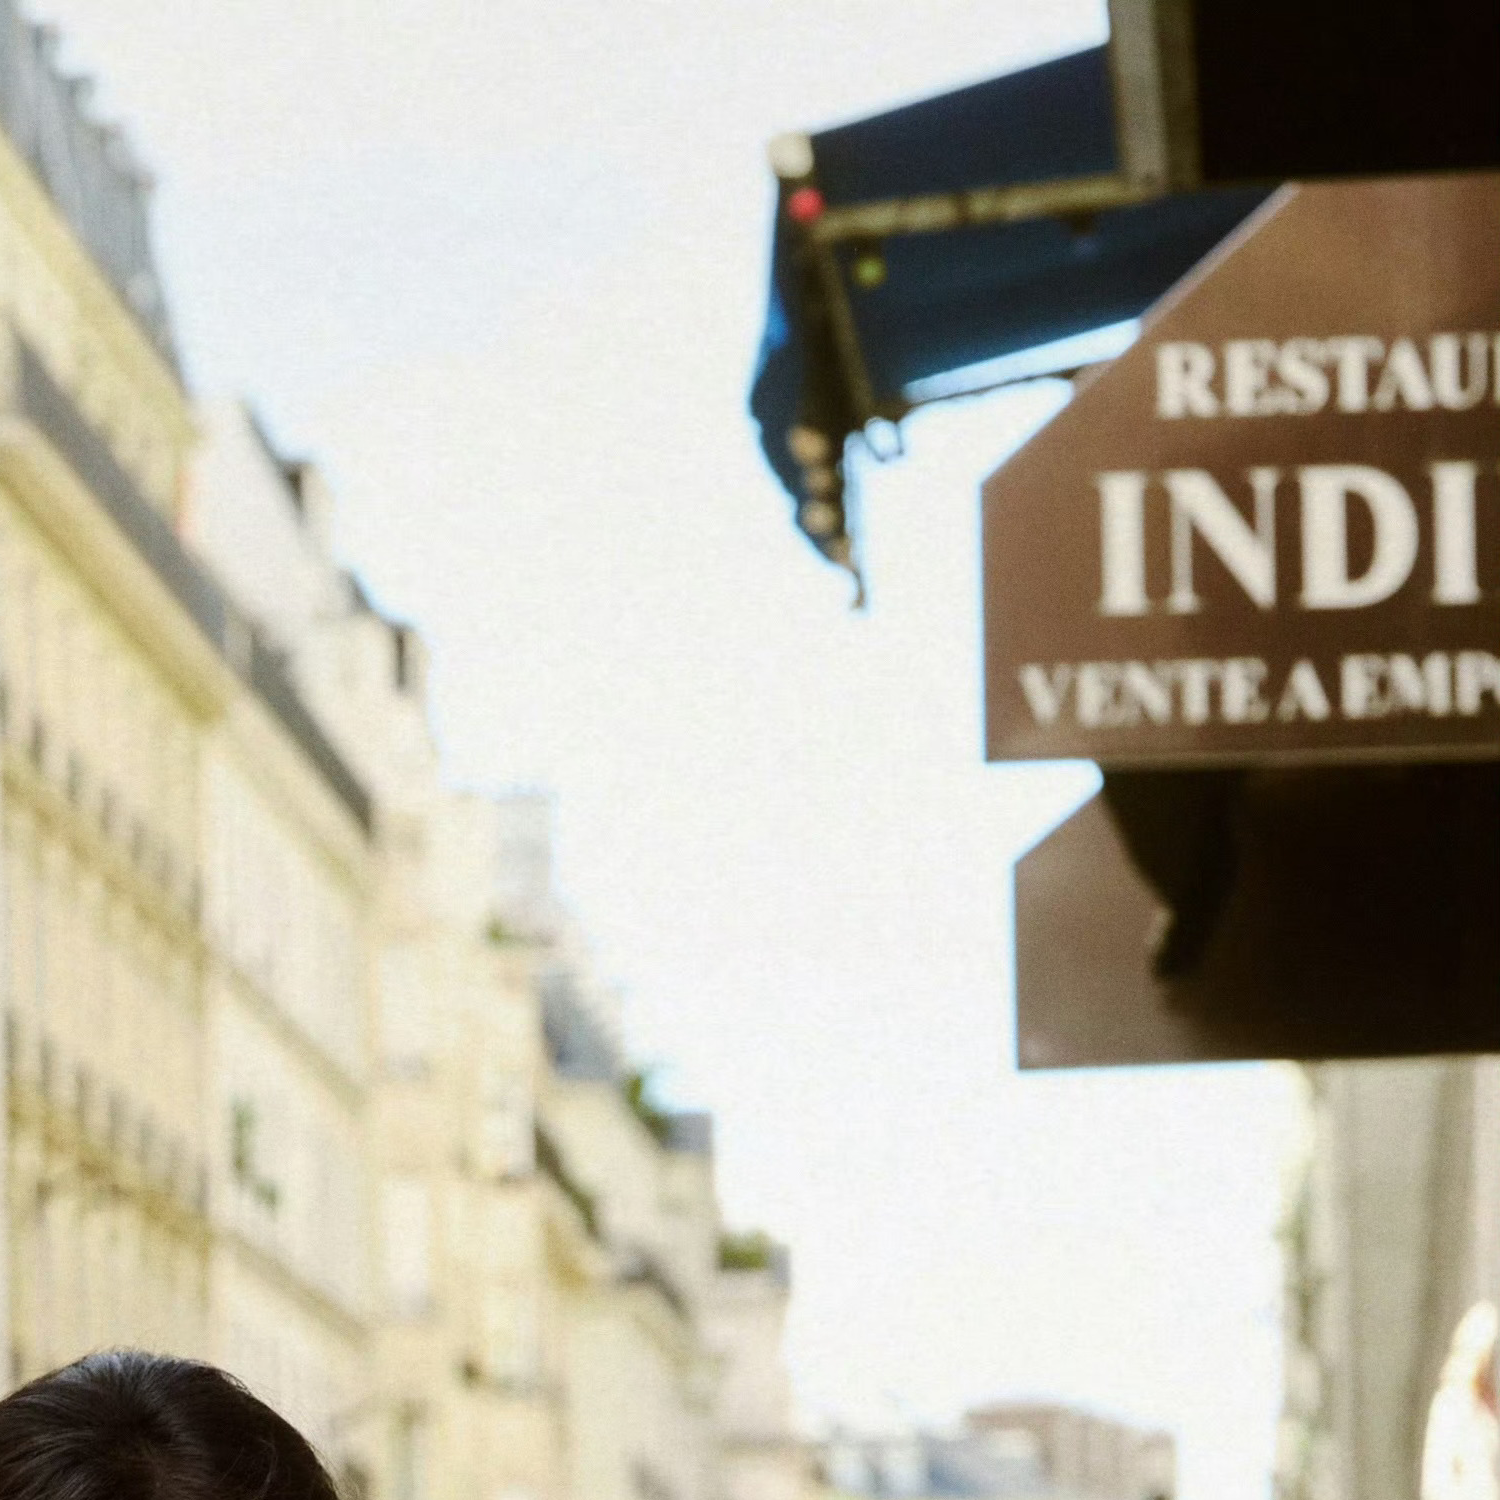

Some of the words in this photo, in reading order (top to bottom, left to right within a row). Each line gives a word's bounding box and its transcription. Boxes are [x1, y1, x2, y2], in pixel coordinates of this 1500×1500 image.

[1155, 331, 1500, 420] RESTAU
[1018, 655, 1269, 729] VENTE
[1276, 657, 1332, 723] A
